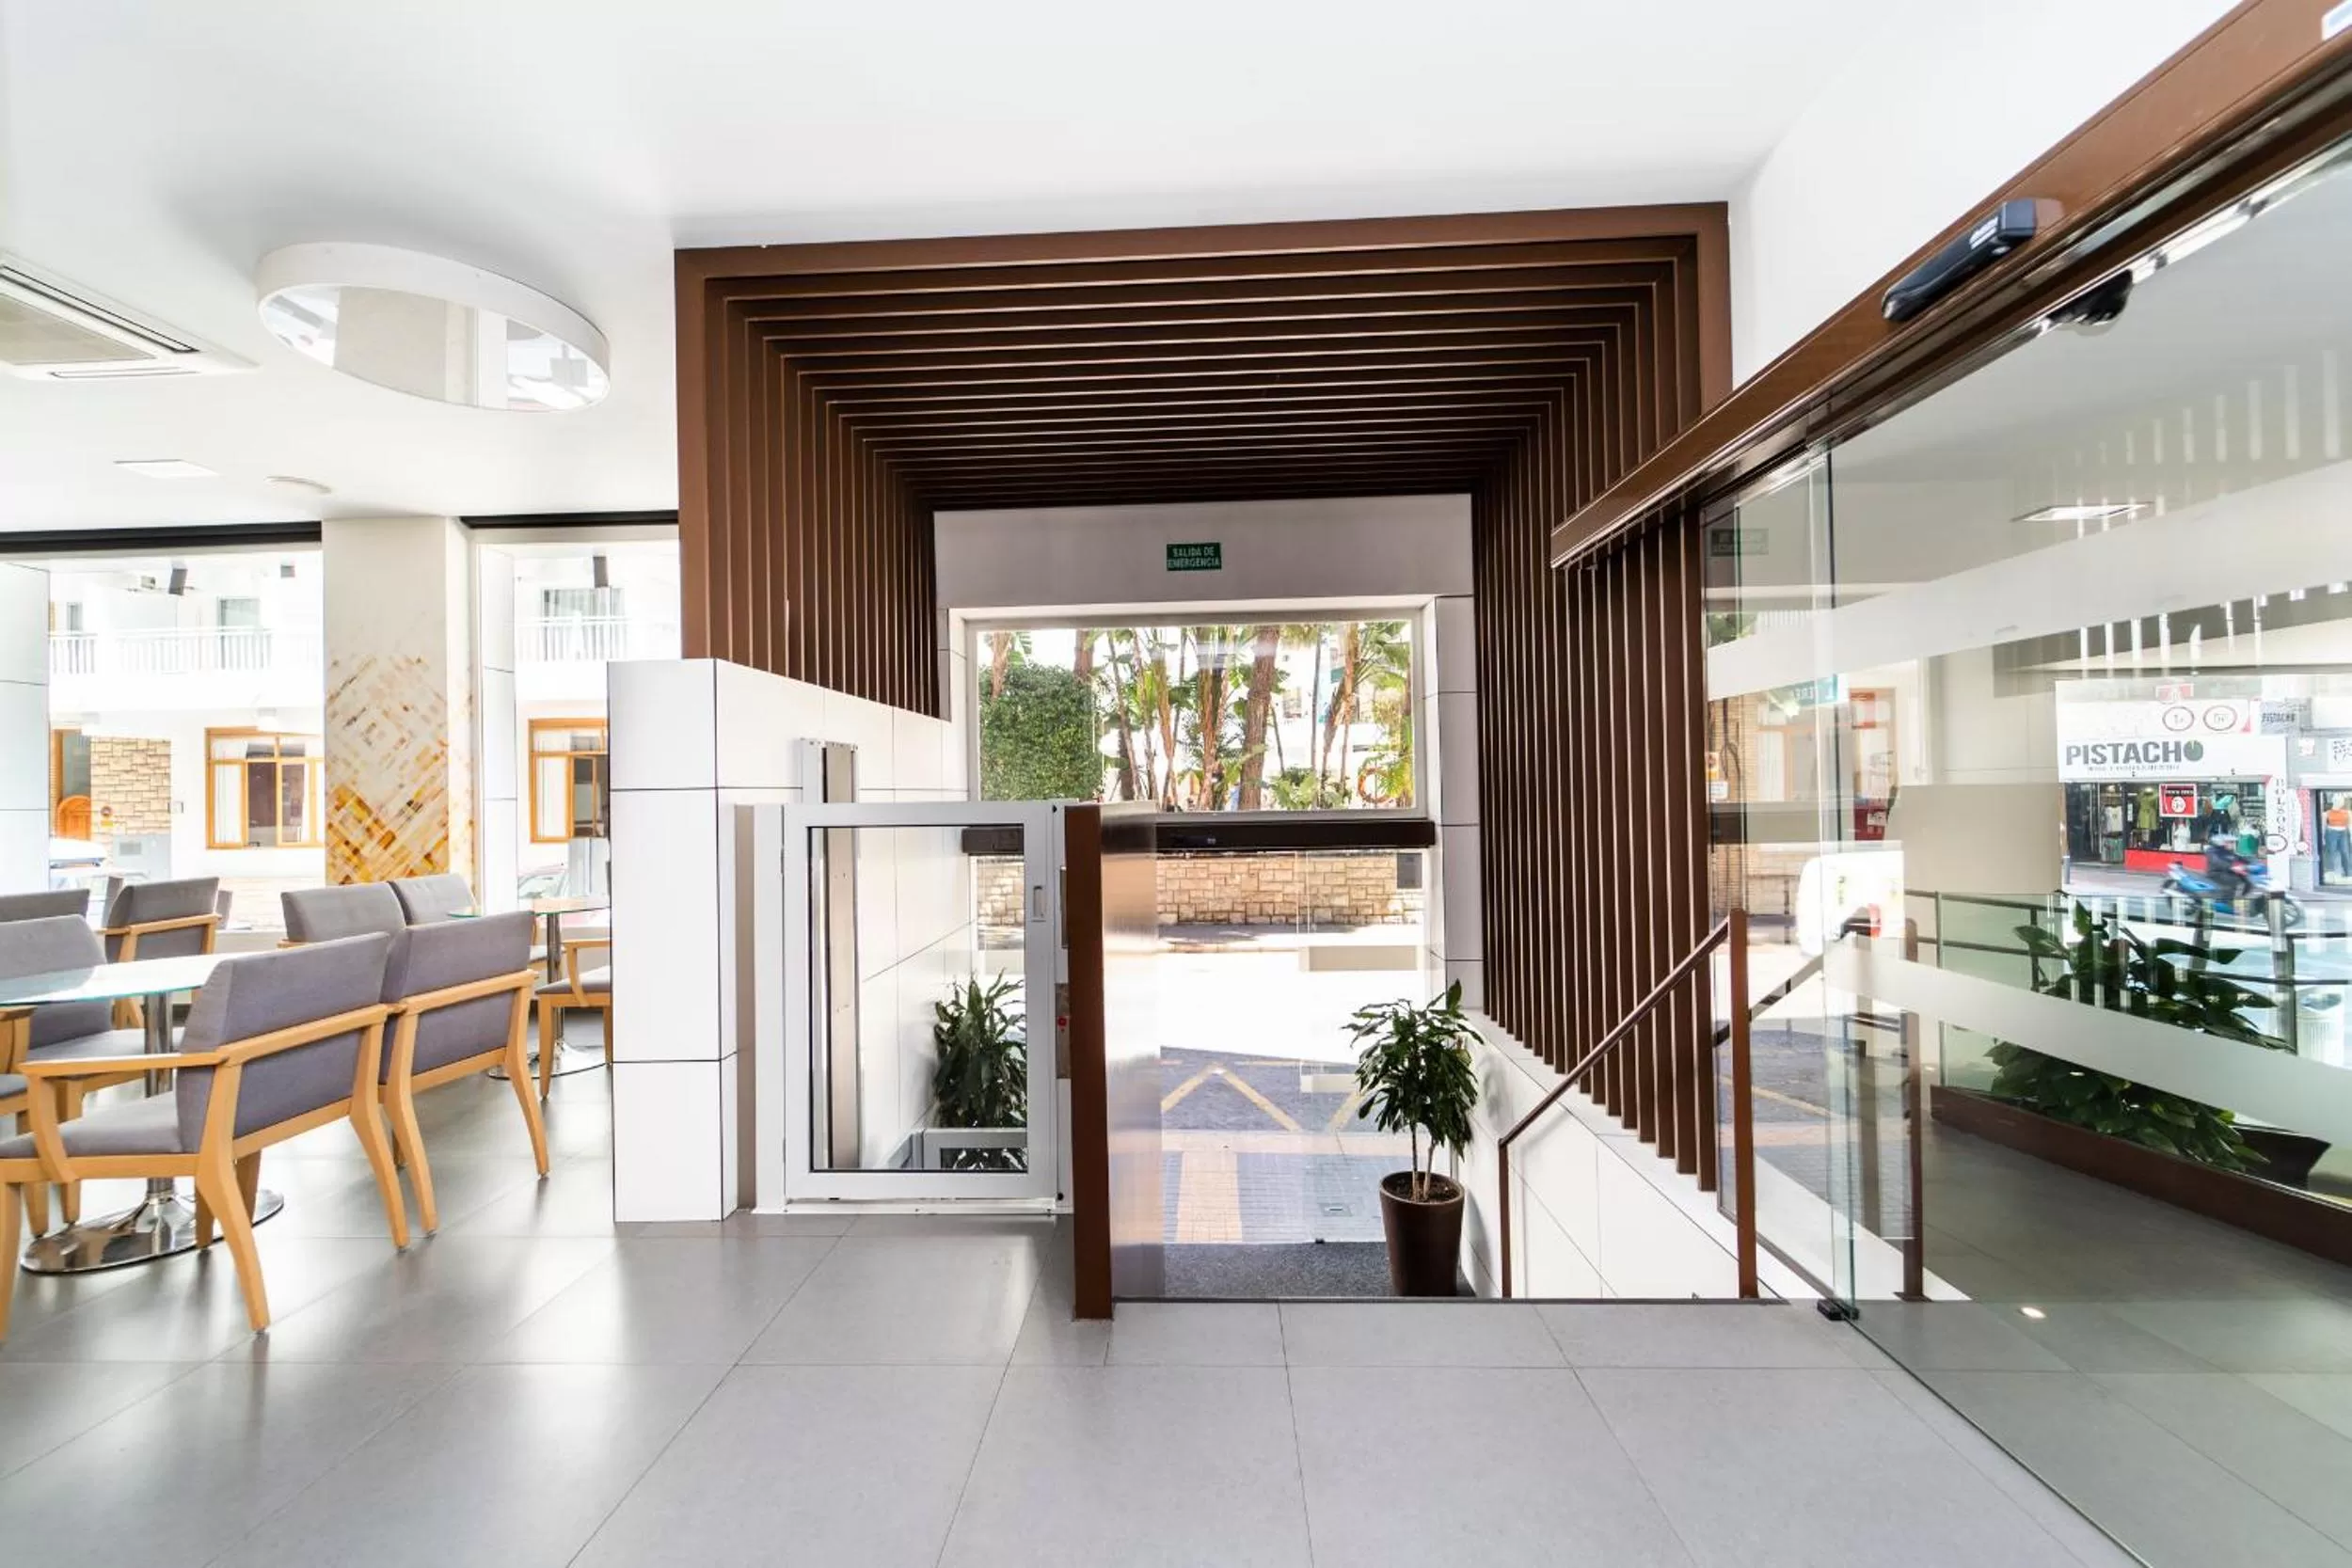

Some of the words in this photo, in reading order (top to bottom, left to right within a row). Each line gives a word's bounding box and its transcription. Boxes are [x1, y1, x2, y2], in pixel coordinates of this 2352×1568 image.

[1172, 547, 1202, 558] SALIDA
[1204, 546, 1216, 557] DE
[1168, 557, 1220, 568] EMERGENCIA
[2066, 739, 2204, 765] PISTACHO
